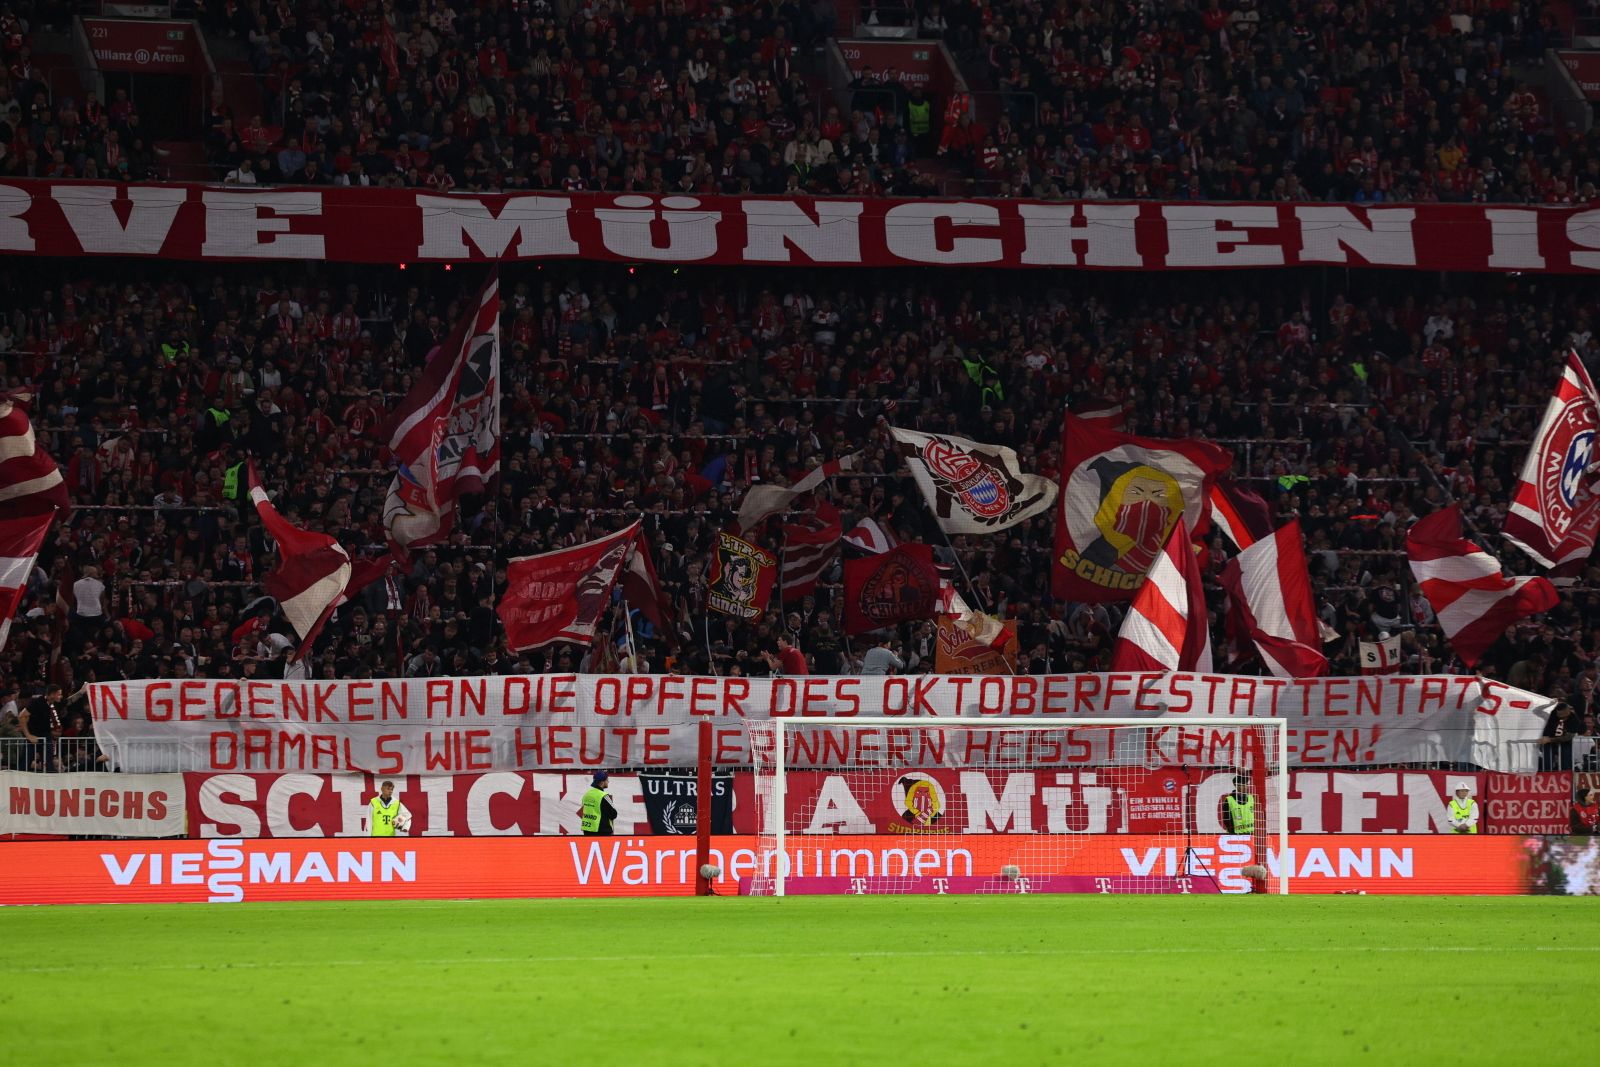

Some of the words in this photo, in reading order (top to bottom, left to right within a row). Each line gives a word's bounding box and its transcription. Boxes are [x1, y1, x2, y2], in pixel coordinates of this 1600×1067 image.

[92, 27, 108, 38] 221
[94, 49, 132, 61] Allianz
[152, 50, 185, 62] Arena
[844, 50, 861, 60] 220
[899, 71, 930, 82] Arena
[1367, 652, 1376, 662] S
[89, 683, 128, 721] IN
[145, 681, 407, 722] GEDENKEN
[426, 679, 486, 719] AN
[502, 676, 576, 716] DIE
[595, 676, 750, 717] OPFER
[769, 678, 860, 717] DES
[209, 729, 403, 774] DAMALS
[425, 729, 492, 771] WIE
[514, 728, 671, 766] HEUTE
[964, 728, 1115, 764] HEISST
[647, 779, 726, 796] ULTRS
[1488, 774, 1572, 794] ULTRAS
[198, 772, 877, 837] SCHICKEIA
[1487, 800, 1571, 820] GEGEN
[100, 839, 416, 902] VIESSMANN
[1120, 834, 1413, 894] VIESSMANN
